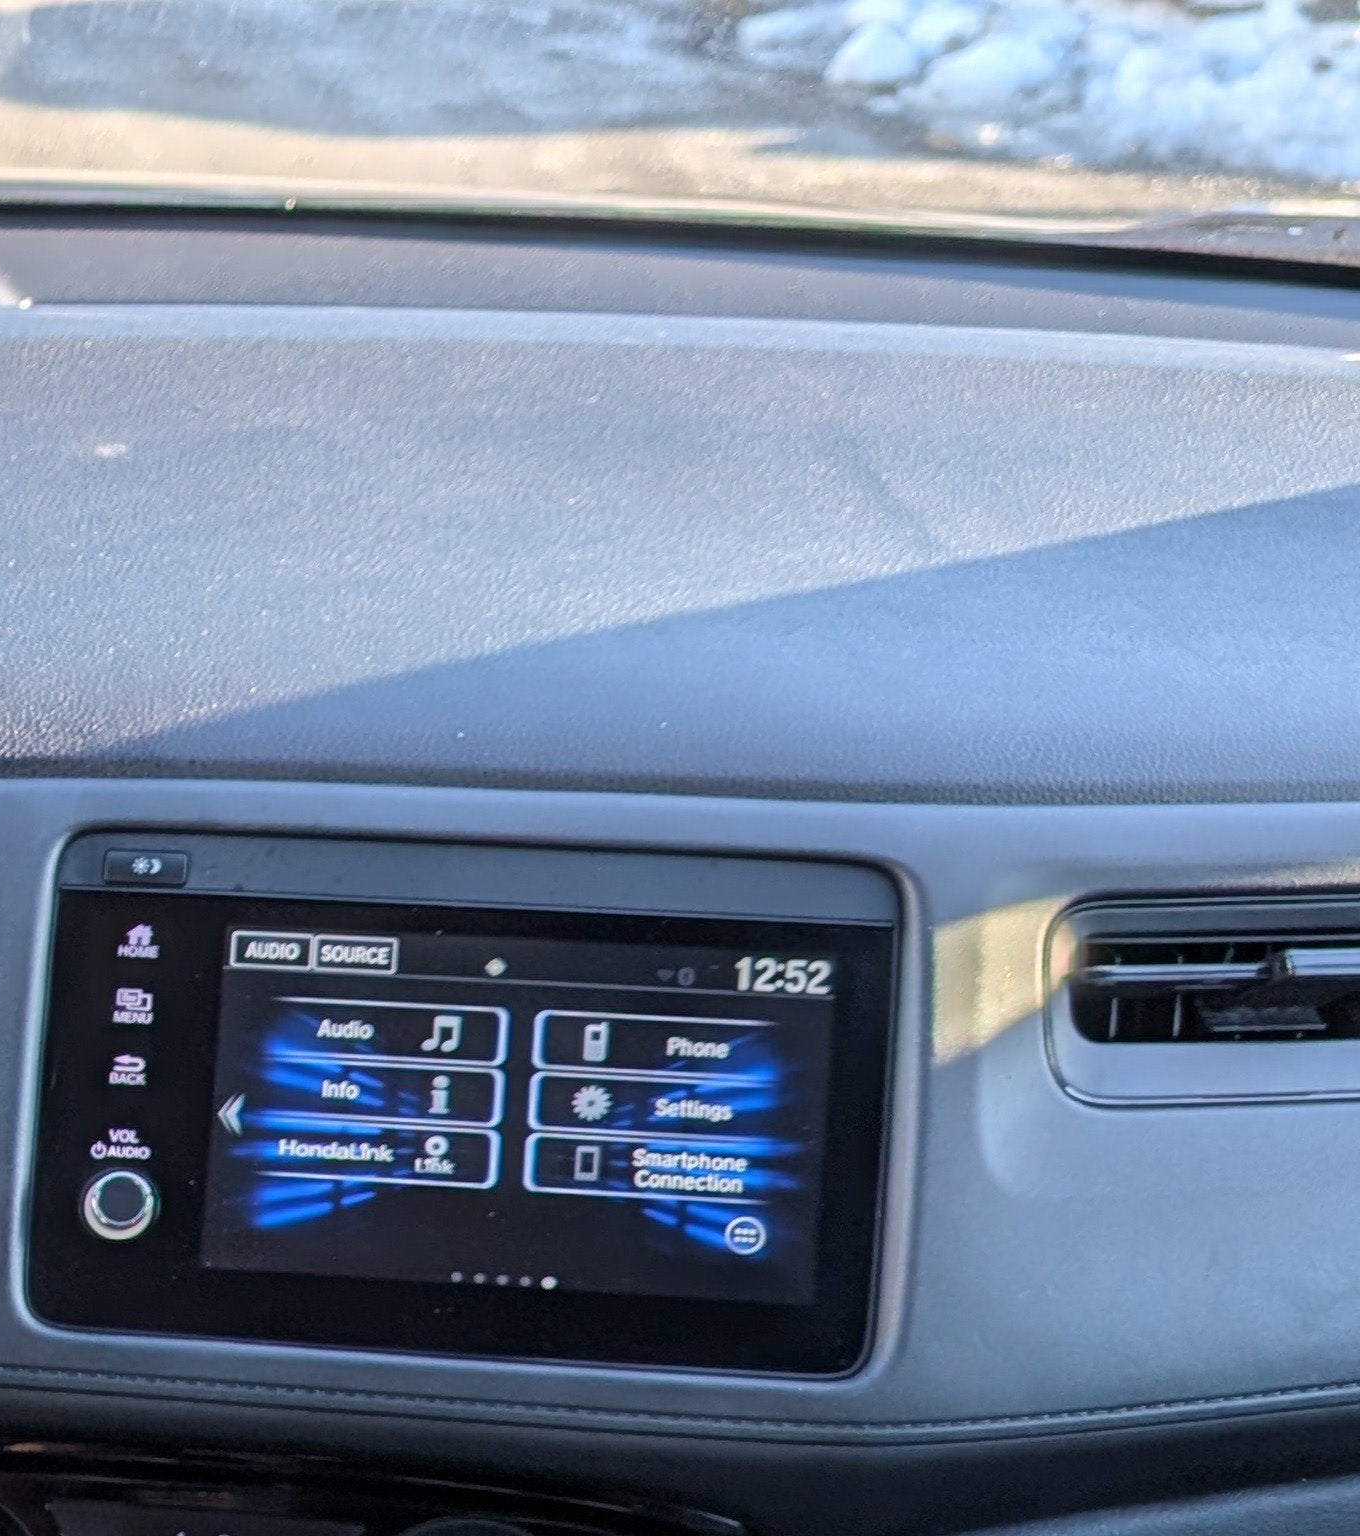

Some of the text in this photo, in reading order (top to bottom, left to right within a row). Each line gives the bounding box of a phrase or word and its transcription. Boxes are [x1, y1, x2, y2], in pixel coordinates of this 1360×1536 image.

[117, 944, 159, 959] HOME
[244, 941, 301, 961] AUDIO
[320, 944, 390, 966] SOURCE
[735, 956, 832, 995] 12:52
[113, 1010, 153, 1025] MENU
[316, 1018, 375, 1041] Audio
[665, 1036, 730, 1060] Phone
[108, 1071, 147, 1086] BACK
[321, 1080, 361, 1100] Info
[654, 1098, 734, 1123] Settings
[108, 1128, 139, 1145] VOL
[107, 1143, 152, 1160] AUDIO
[278, 1138, 396, 1164] HondaLink
[632, 1147, 750, 1173] Smartphone
[633, 1171, 745, 1194] Connection
